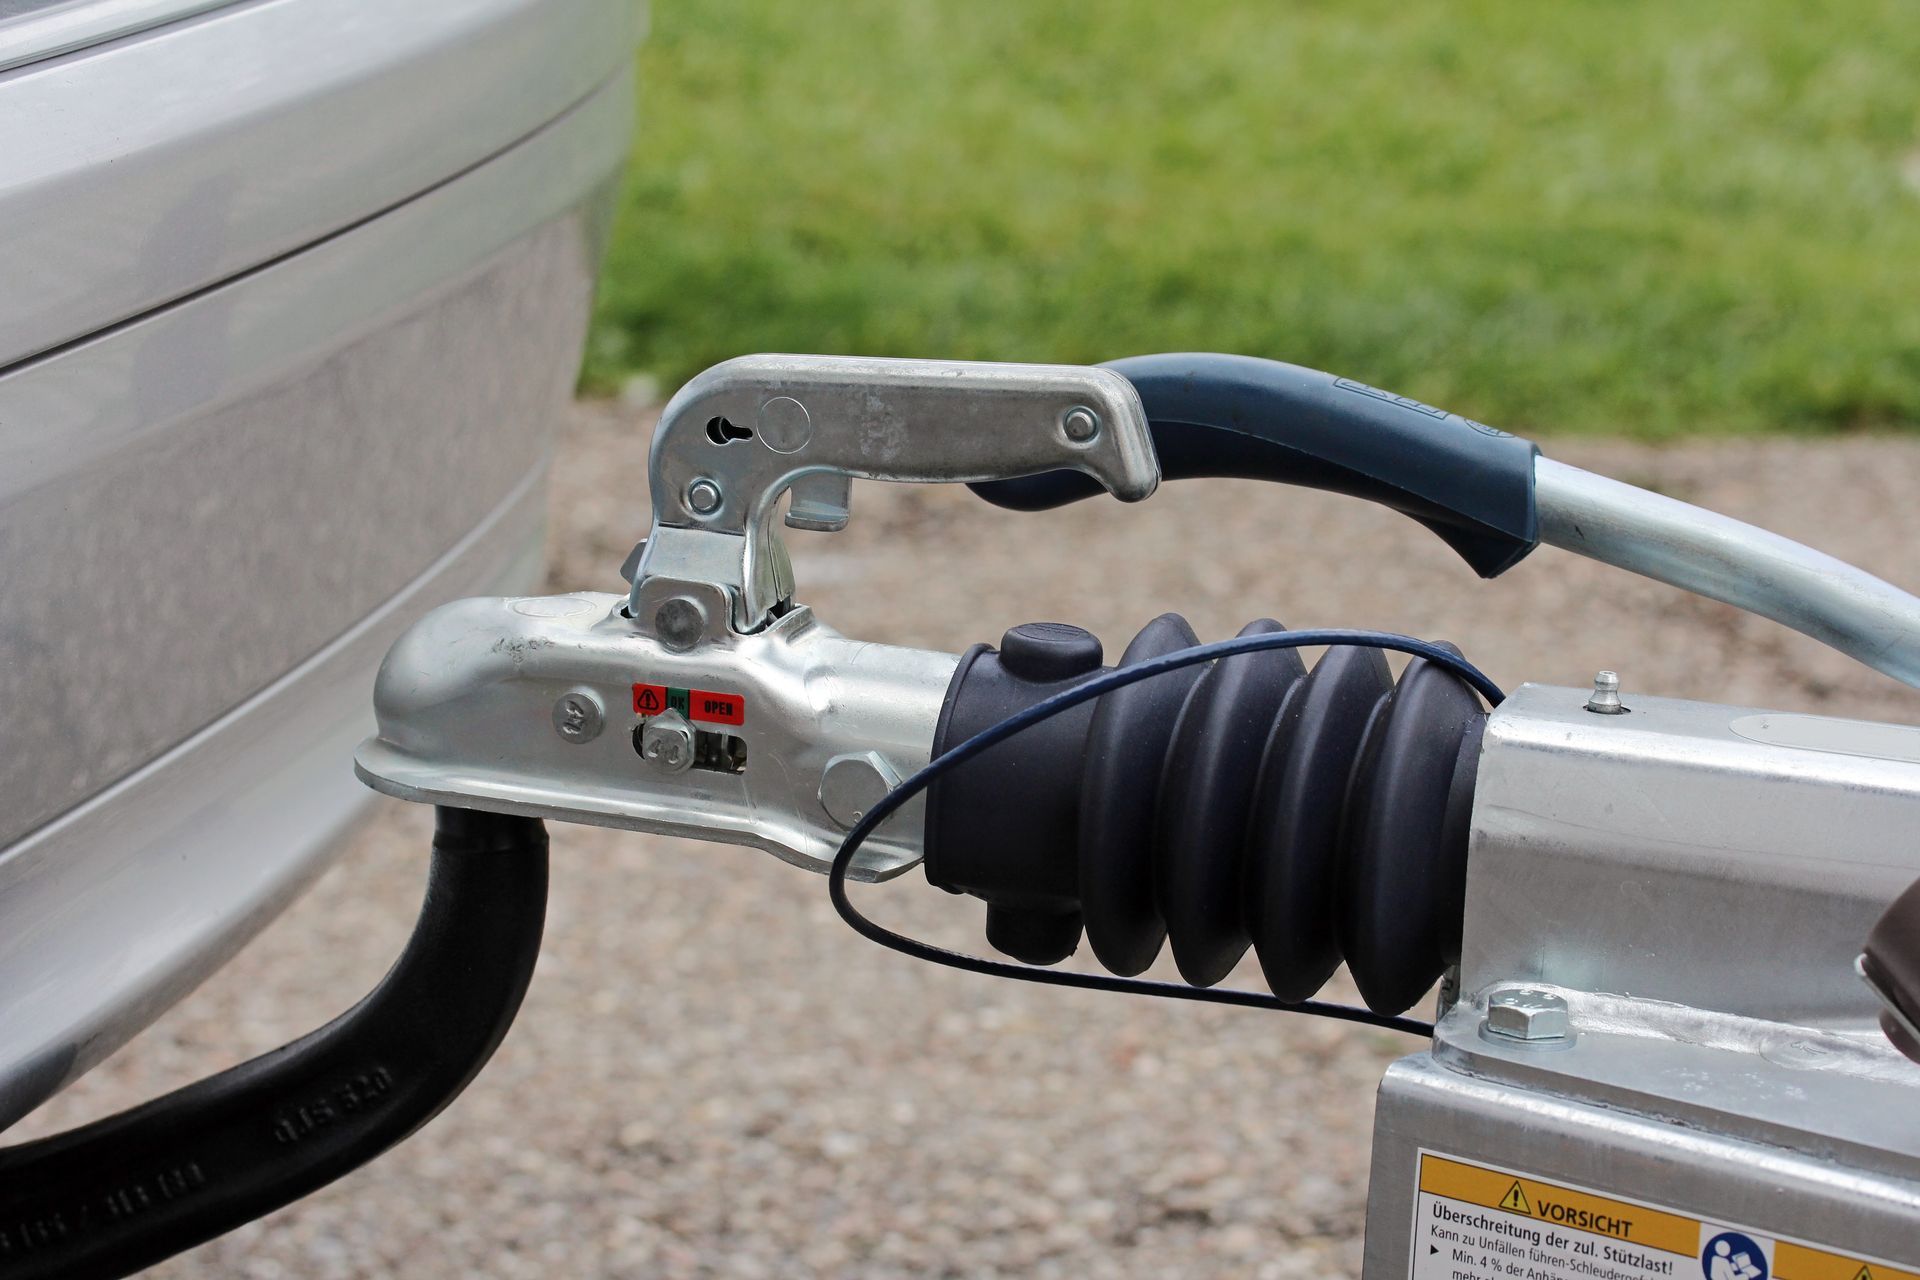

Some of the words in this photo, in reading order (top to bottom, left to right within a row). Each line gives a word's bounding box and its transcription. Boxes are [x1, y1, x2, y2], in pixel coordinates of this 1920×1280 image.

[670, 695, 686, 711] OK
[704, 700, 734, 717] OPEN
[1537, 1200, 1633, 1238] VORSICHT
[1430, 1223, 1459, 1242] Kann
[1462, 1234, 1475, 1247] zu
[1479, 1235, 1525, 1259] Unfällen
[1432, 1200, 1541, 1246] Überschreitung
[1545, 1231, 1570, 1250] der
[1574, 1241, 1599, 1257] zul.
[1603, 1246, 1673, 1276] Stützlast!
[1452, 1248, 1477, 1266] Min.
[1480, 1255, 1488, 1269] 4
[1491, 1257, 1503, 1272] %
[1506, 1262, 1525, 1277] der
